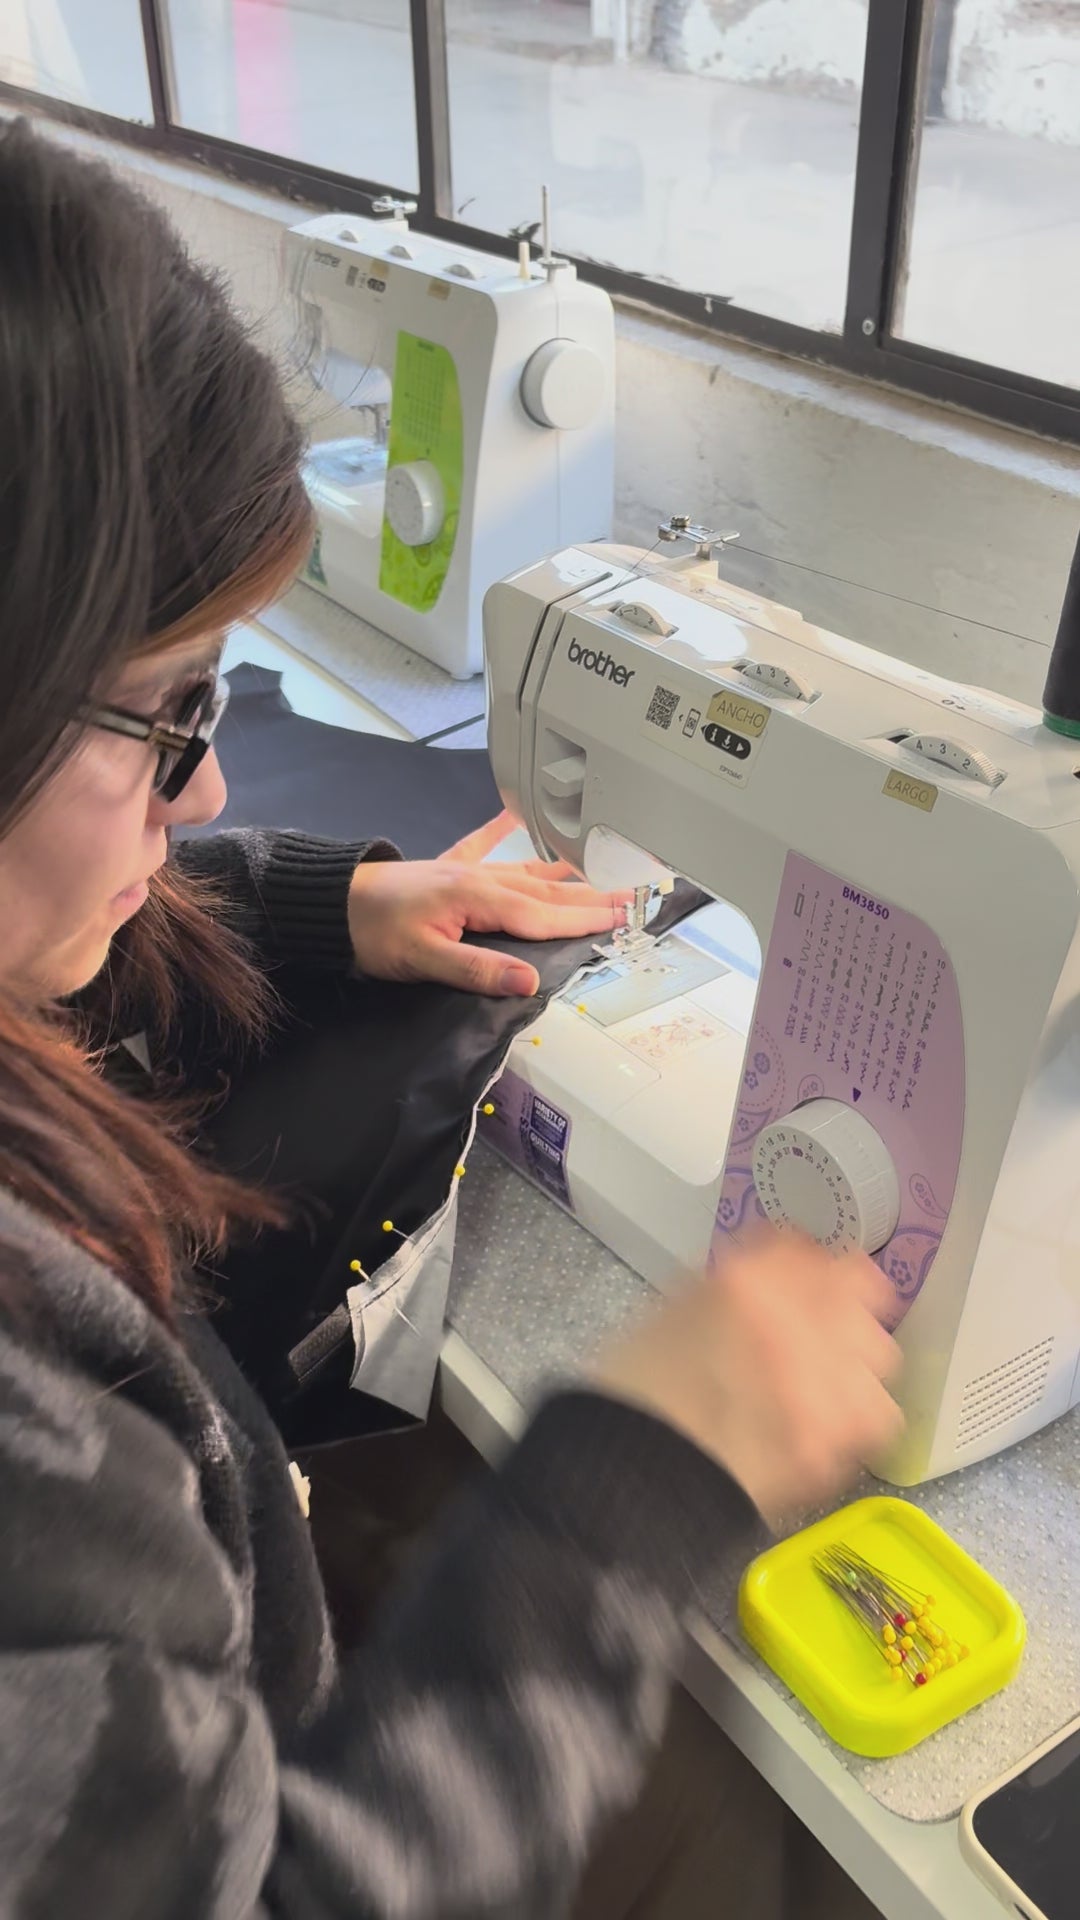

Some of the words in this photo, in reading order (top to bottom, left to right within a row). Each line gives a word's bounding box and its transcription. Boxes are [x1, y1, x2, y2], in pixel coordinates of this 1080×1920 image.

[568, 637, 636, 687] brother
[770, 667, 776, 678] 3
[783, 676, 790, 687] 2
[716, 700, 765, 728] ANCHO
[916, 739, 923, 751] 4
[939, 743, 947, 755] 3
[962, 758, 971, 770] 2
[886, 779, 929, 804] LARGO
[842, 886, 890, 920] BM3850
[937, 959, 946, 970] 10
[530, 1132, 561, 1163] QUILTING
